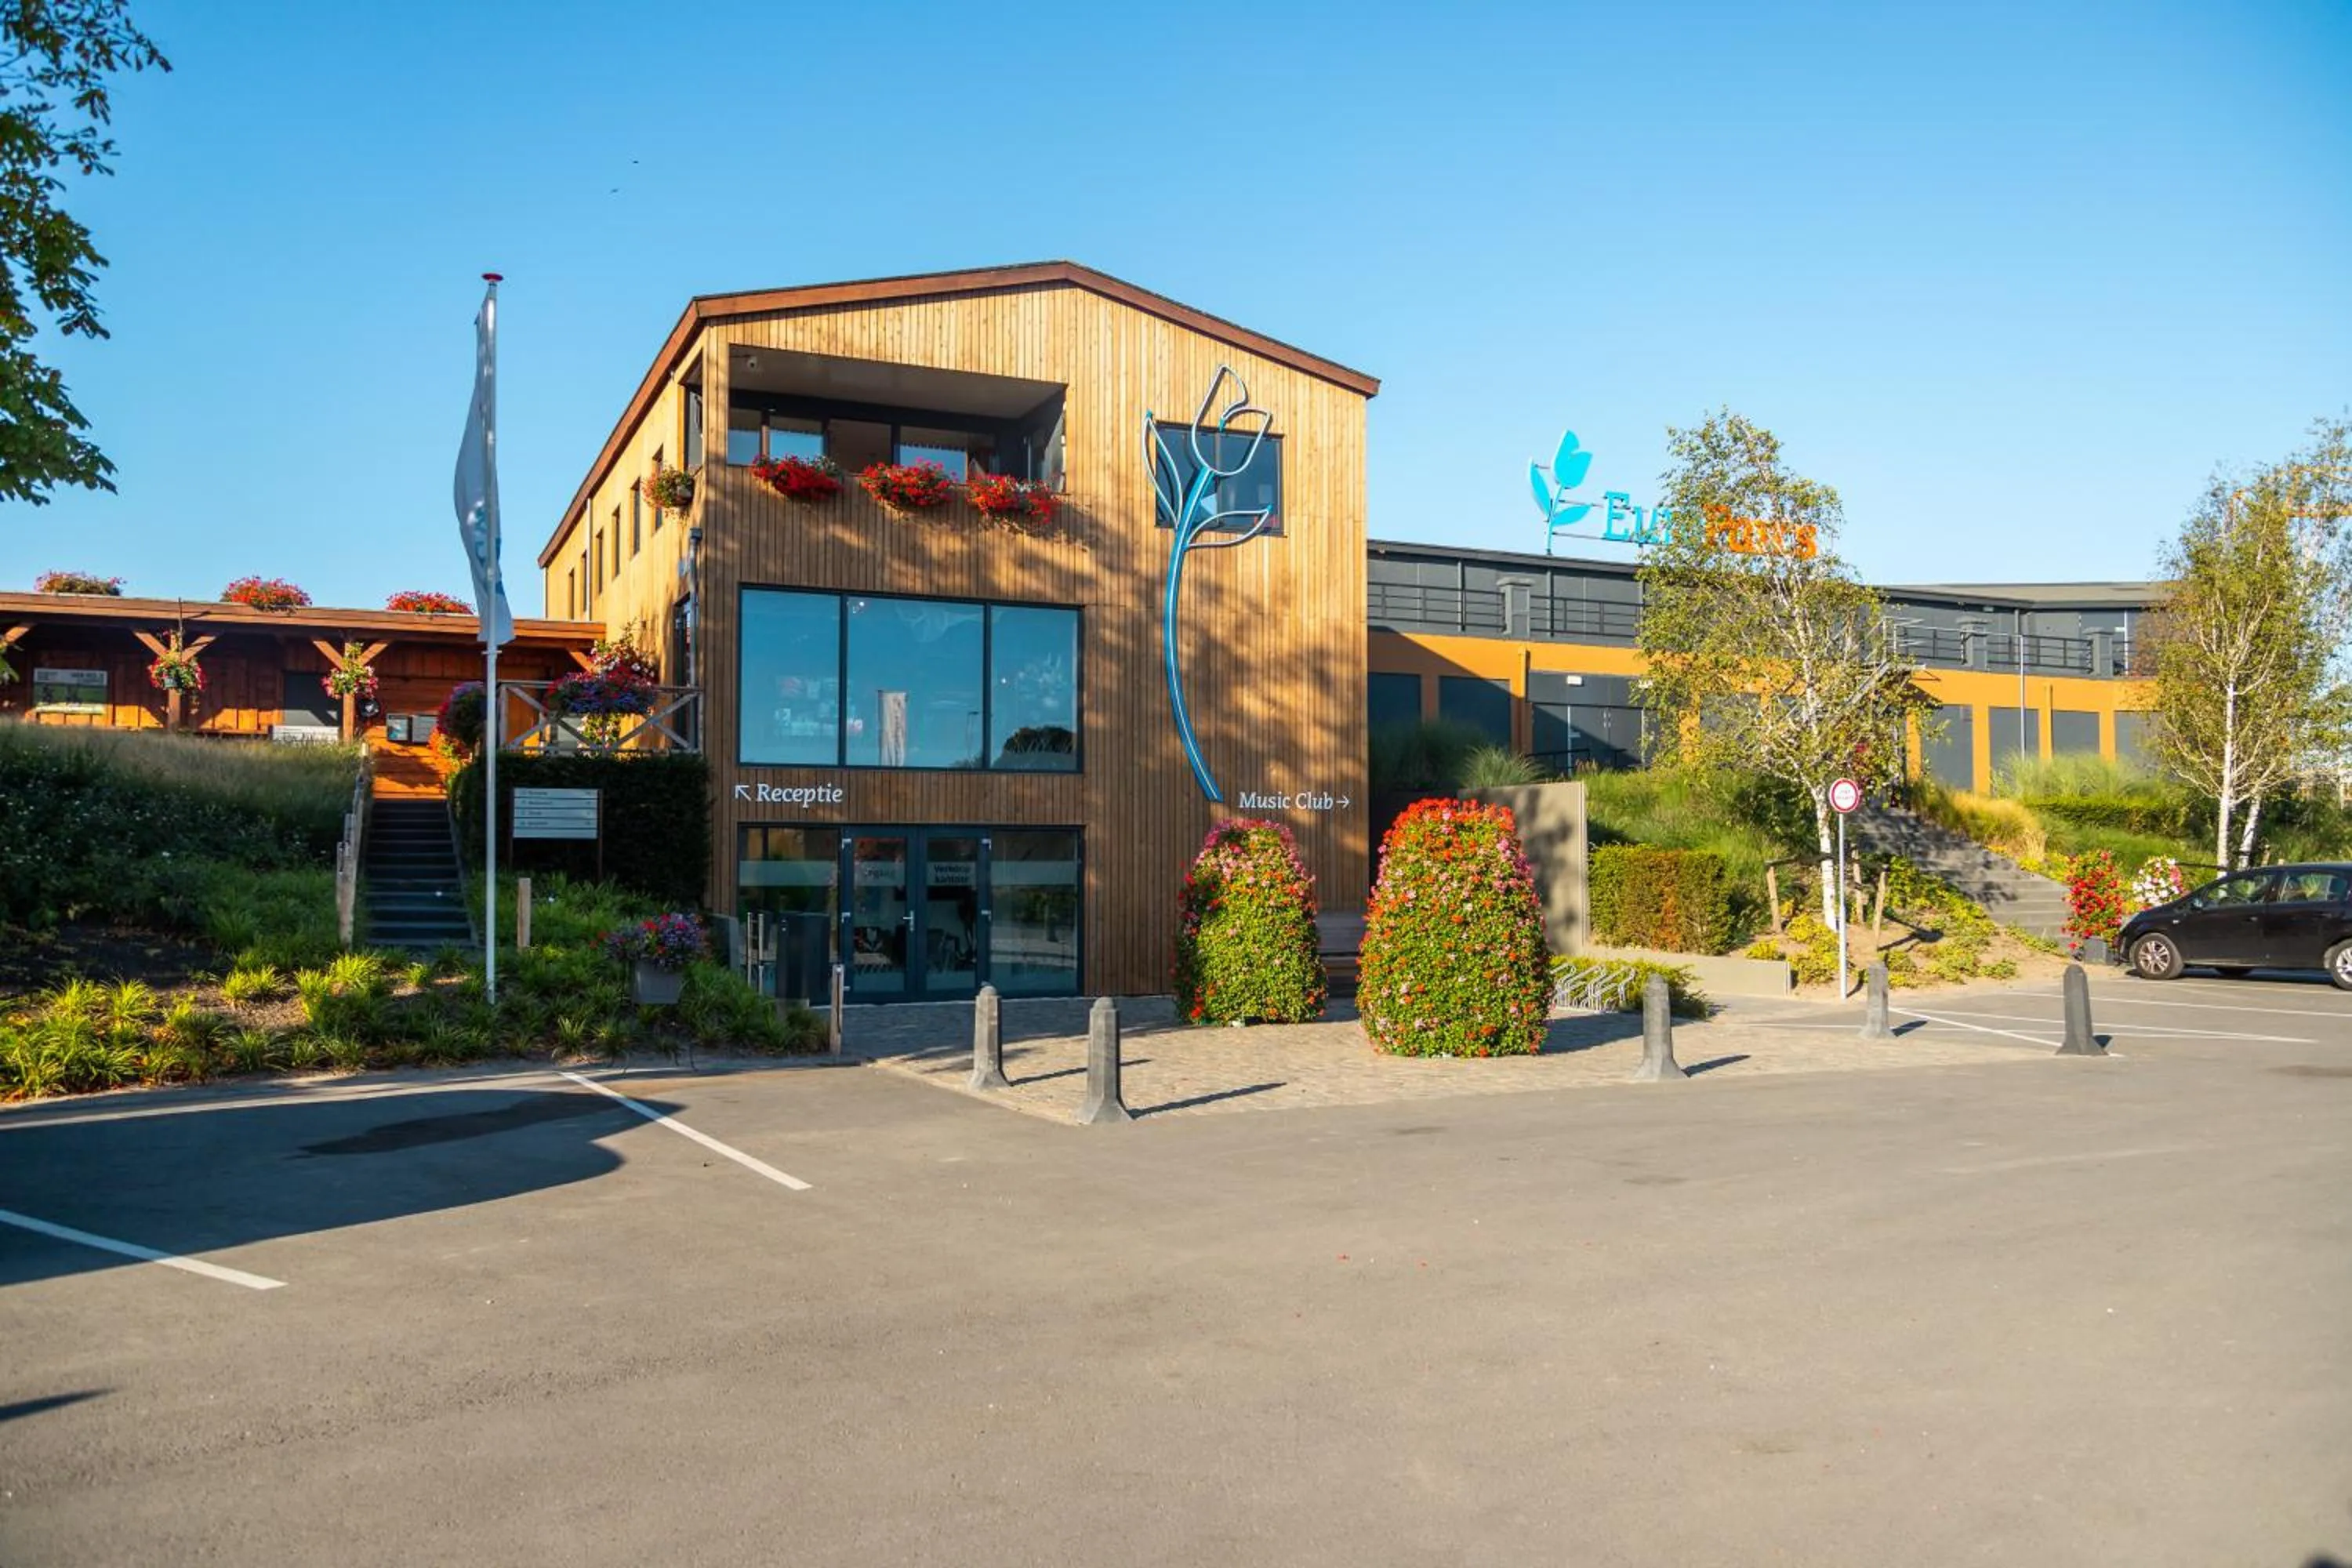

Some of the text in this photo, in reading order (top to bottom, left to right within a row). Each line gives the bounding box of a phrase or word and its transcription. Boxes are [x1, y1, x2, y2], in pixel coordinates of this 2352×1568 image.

[757, 782, 843, 808] Receptie
[1239, 791, 1334, 810] Music Club
